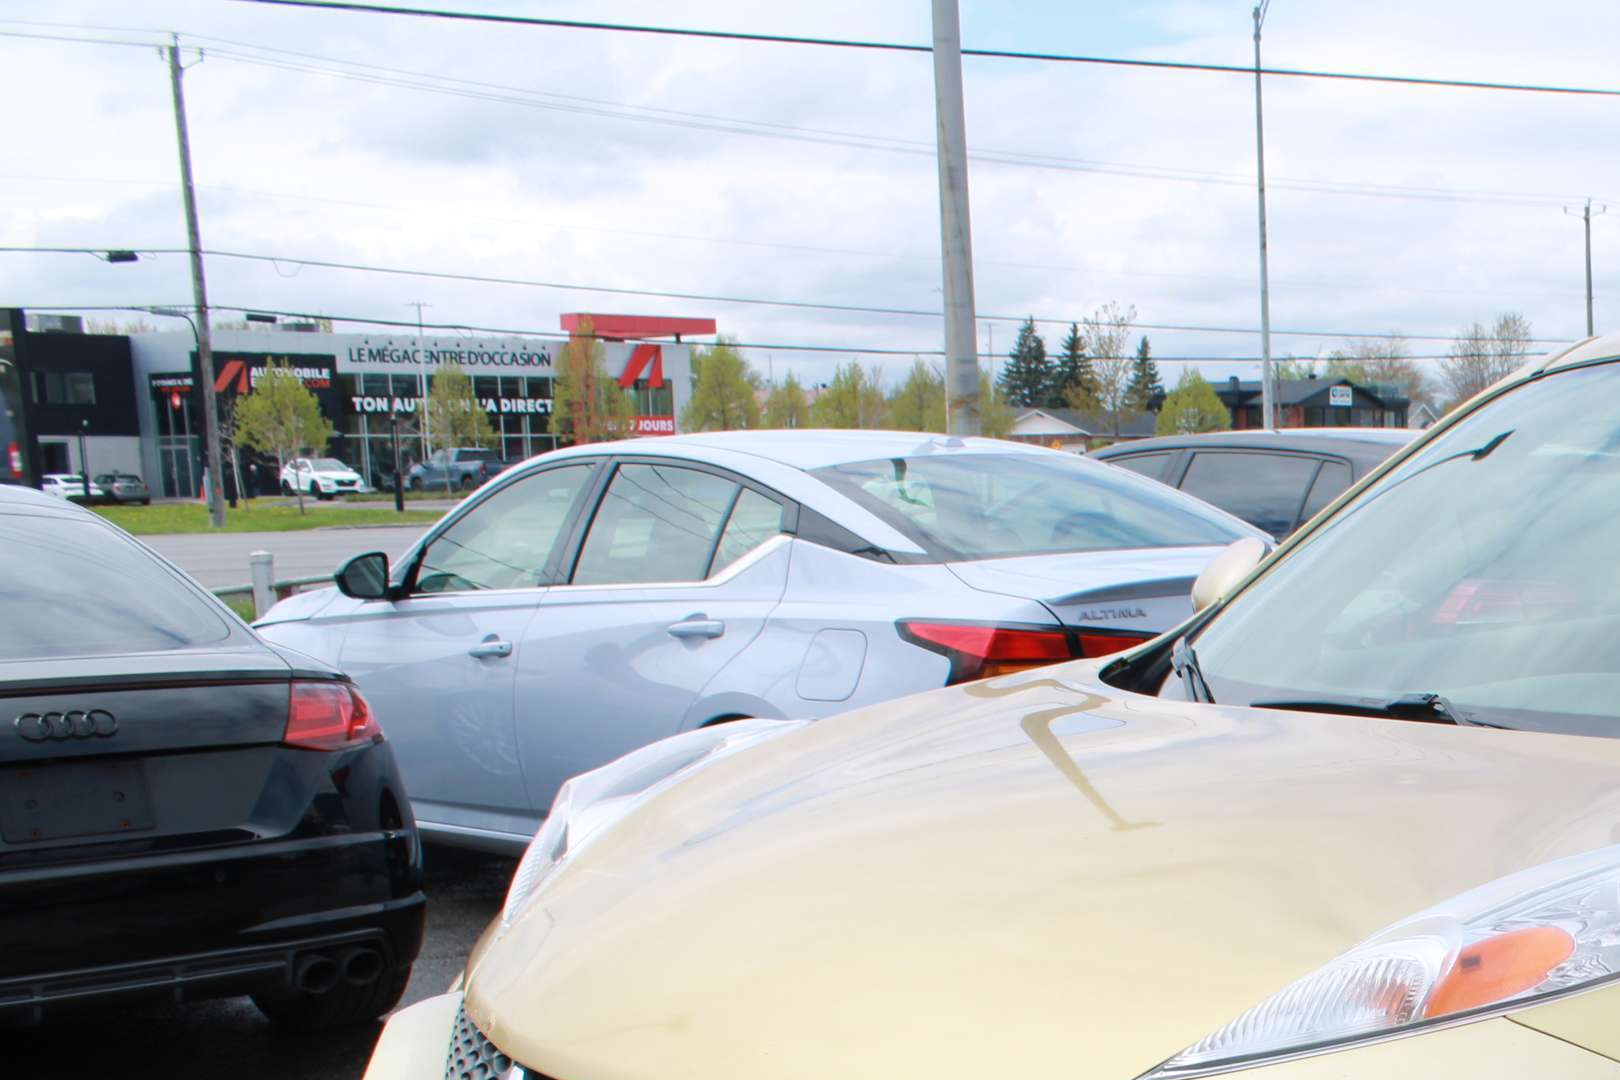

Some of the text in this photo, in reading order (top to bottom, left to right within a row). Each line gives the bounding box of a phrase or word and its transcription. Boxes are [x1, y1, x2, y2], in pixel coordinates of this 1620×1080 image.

[349, 348, 367, 363] LE
[468, 350, 551, 367] D'OCCASION
[352, 396, 388, 413] TON
[501, 398, 553, 413] DIRECT
[639, 419, 674, 432] JOURS
[1079, 607, 1147, 621] ALTIMA
